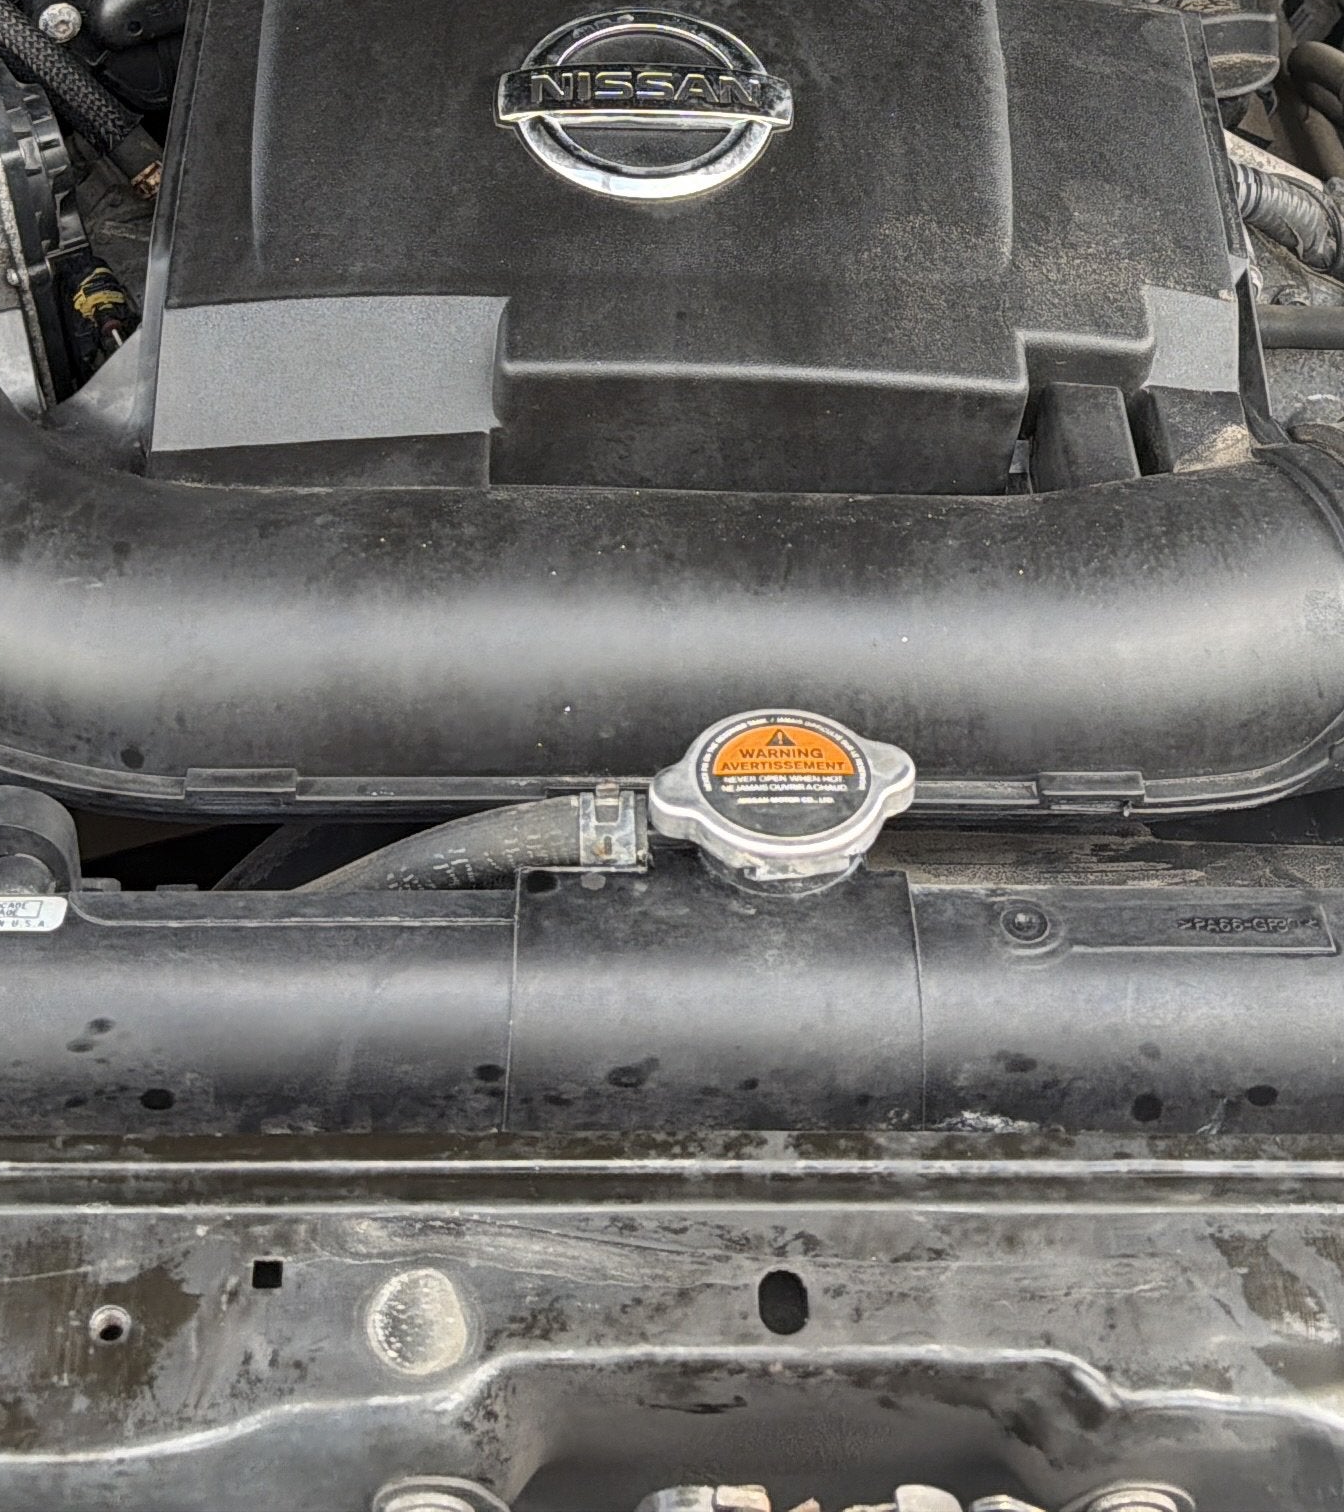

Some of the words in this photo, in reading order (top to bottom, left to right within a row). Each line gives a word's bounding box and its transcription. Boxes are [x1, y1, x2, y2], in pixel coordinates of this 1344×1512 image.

[530, 72, 760, 105] NISSAN
[738, 747, 824, 759] WARNING
[721, 760, 845, 772] AVERTISSEMENT
